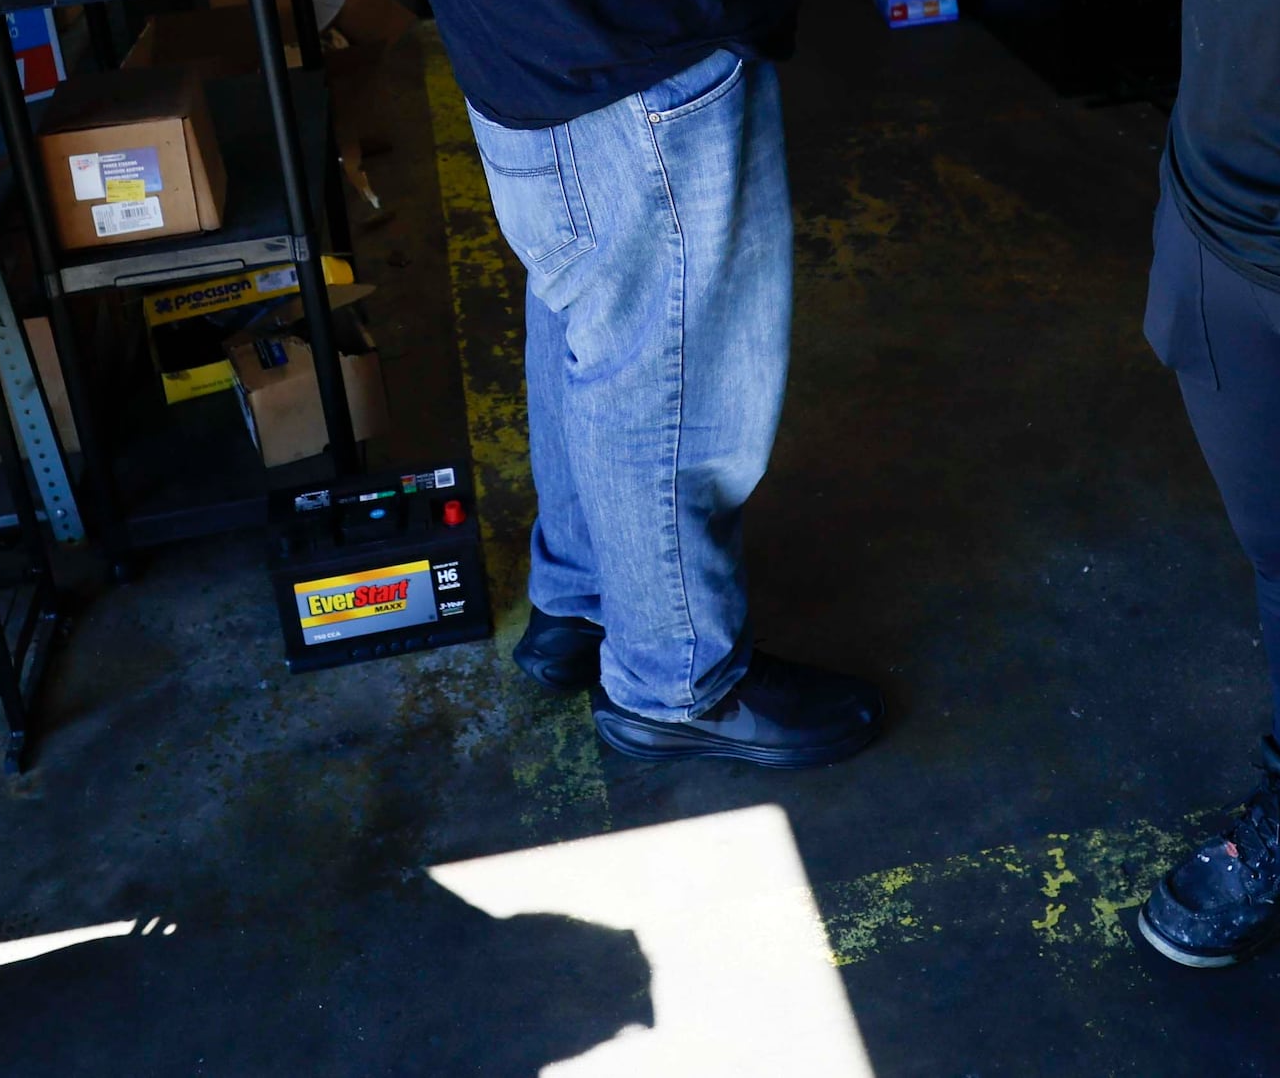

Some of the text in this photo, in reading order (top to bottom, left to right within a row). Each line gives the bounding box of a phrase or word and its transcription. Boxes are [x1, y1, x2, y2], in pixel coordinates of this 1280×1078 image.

[175, 279, 251, 310] precision
[437, 567, 458, 583] H6
[307, 579, 410, 616] EverStart
[374, 602, 403, 613] MAXX
